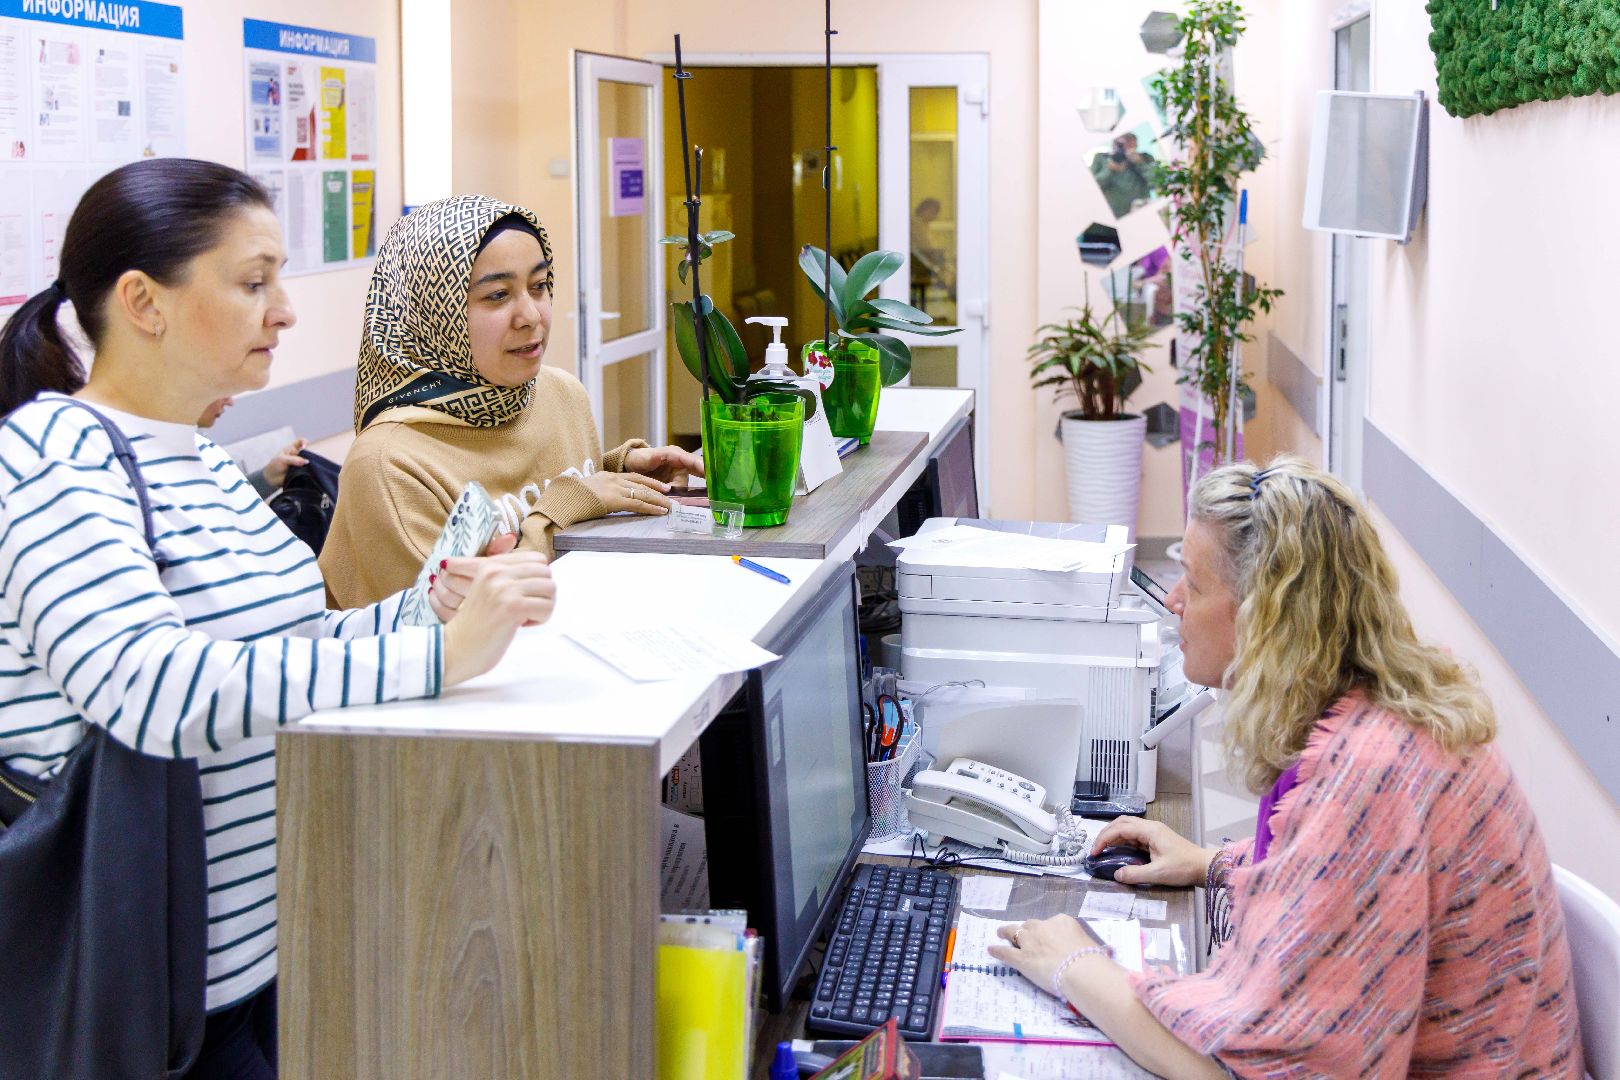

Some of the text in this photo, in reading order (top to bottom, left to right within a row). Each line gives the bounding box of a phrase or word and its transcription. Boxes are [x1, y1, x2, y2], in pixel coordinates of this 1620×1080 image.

[22, 0, 140, 29] ИНФОРМАЦИЯ
[279, 29, 350, 57] ИНФОРМАЦИЯ
[388, 379, 443, 404] GIVENCHY
